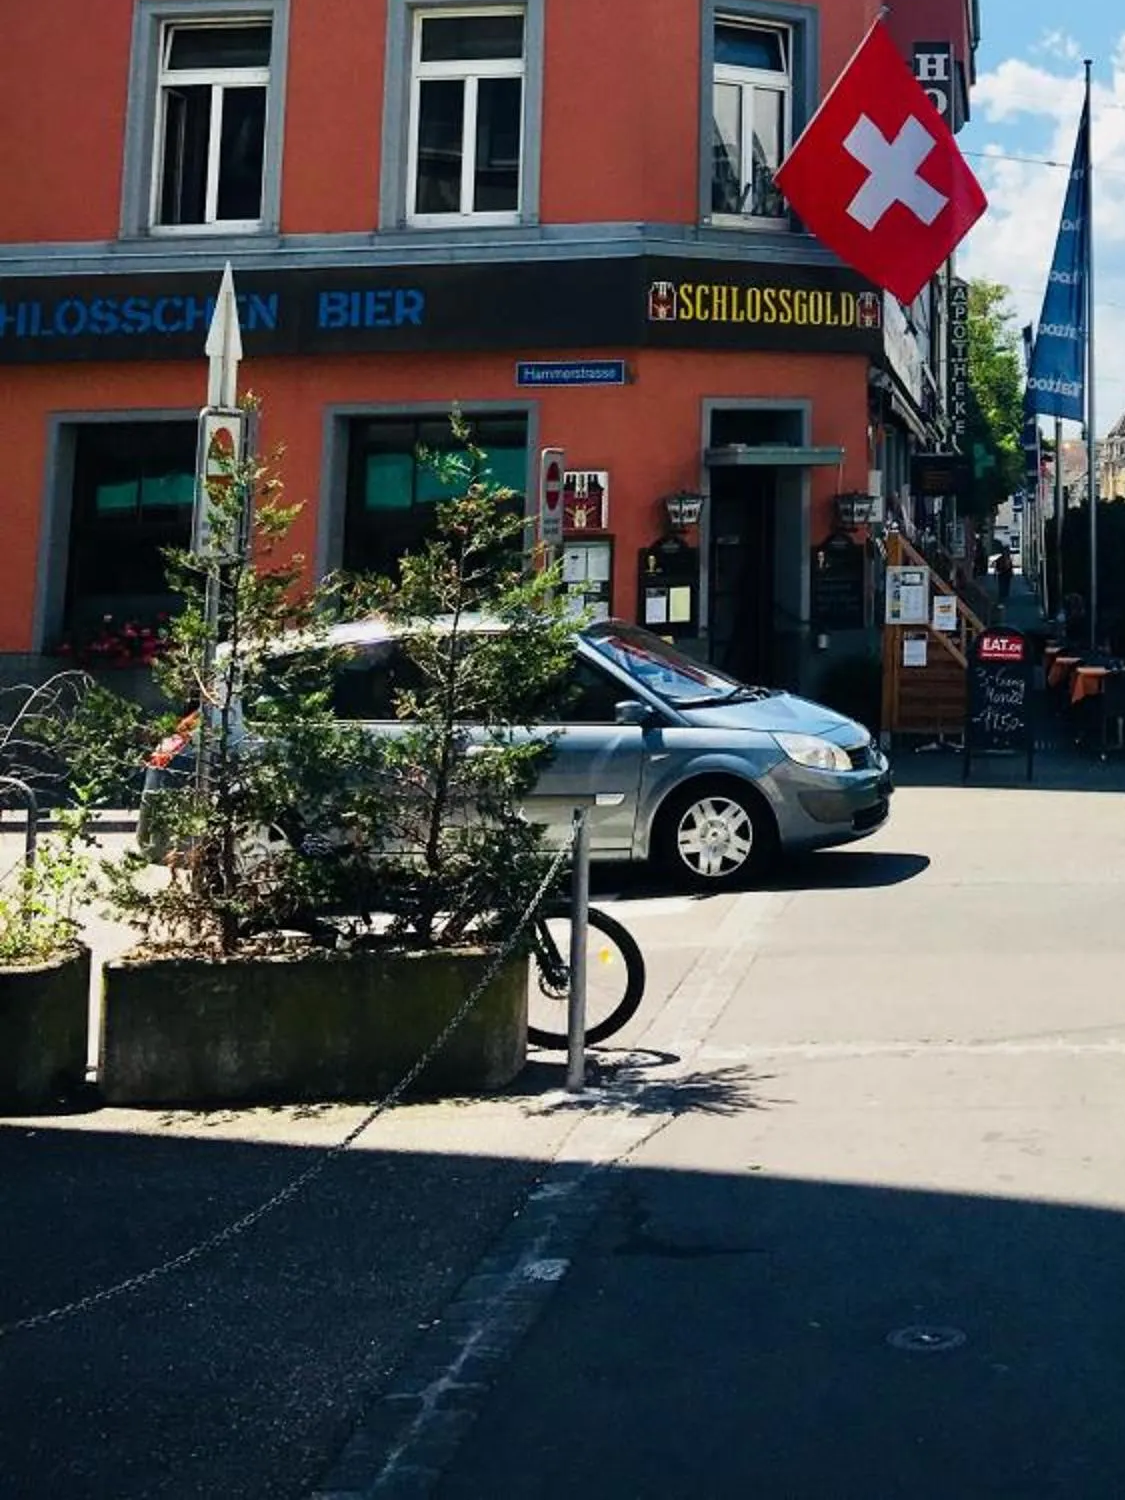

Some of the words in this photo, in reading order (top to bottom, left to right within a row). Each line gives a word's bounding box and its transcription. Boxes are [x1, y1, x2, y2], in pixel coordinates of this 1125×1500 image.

[318, 289, 426, 328] BIER
[679, 283, 855, 327] SCHLOSSGOLD
[523, 367, 617, 380] Hammerstrasse
[953, 287, 967, 436] APOTHEKE
